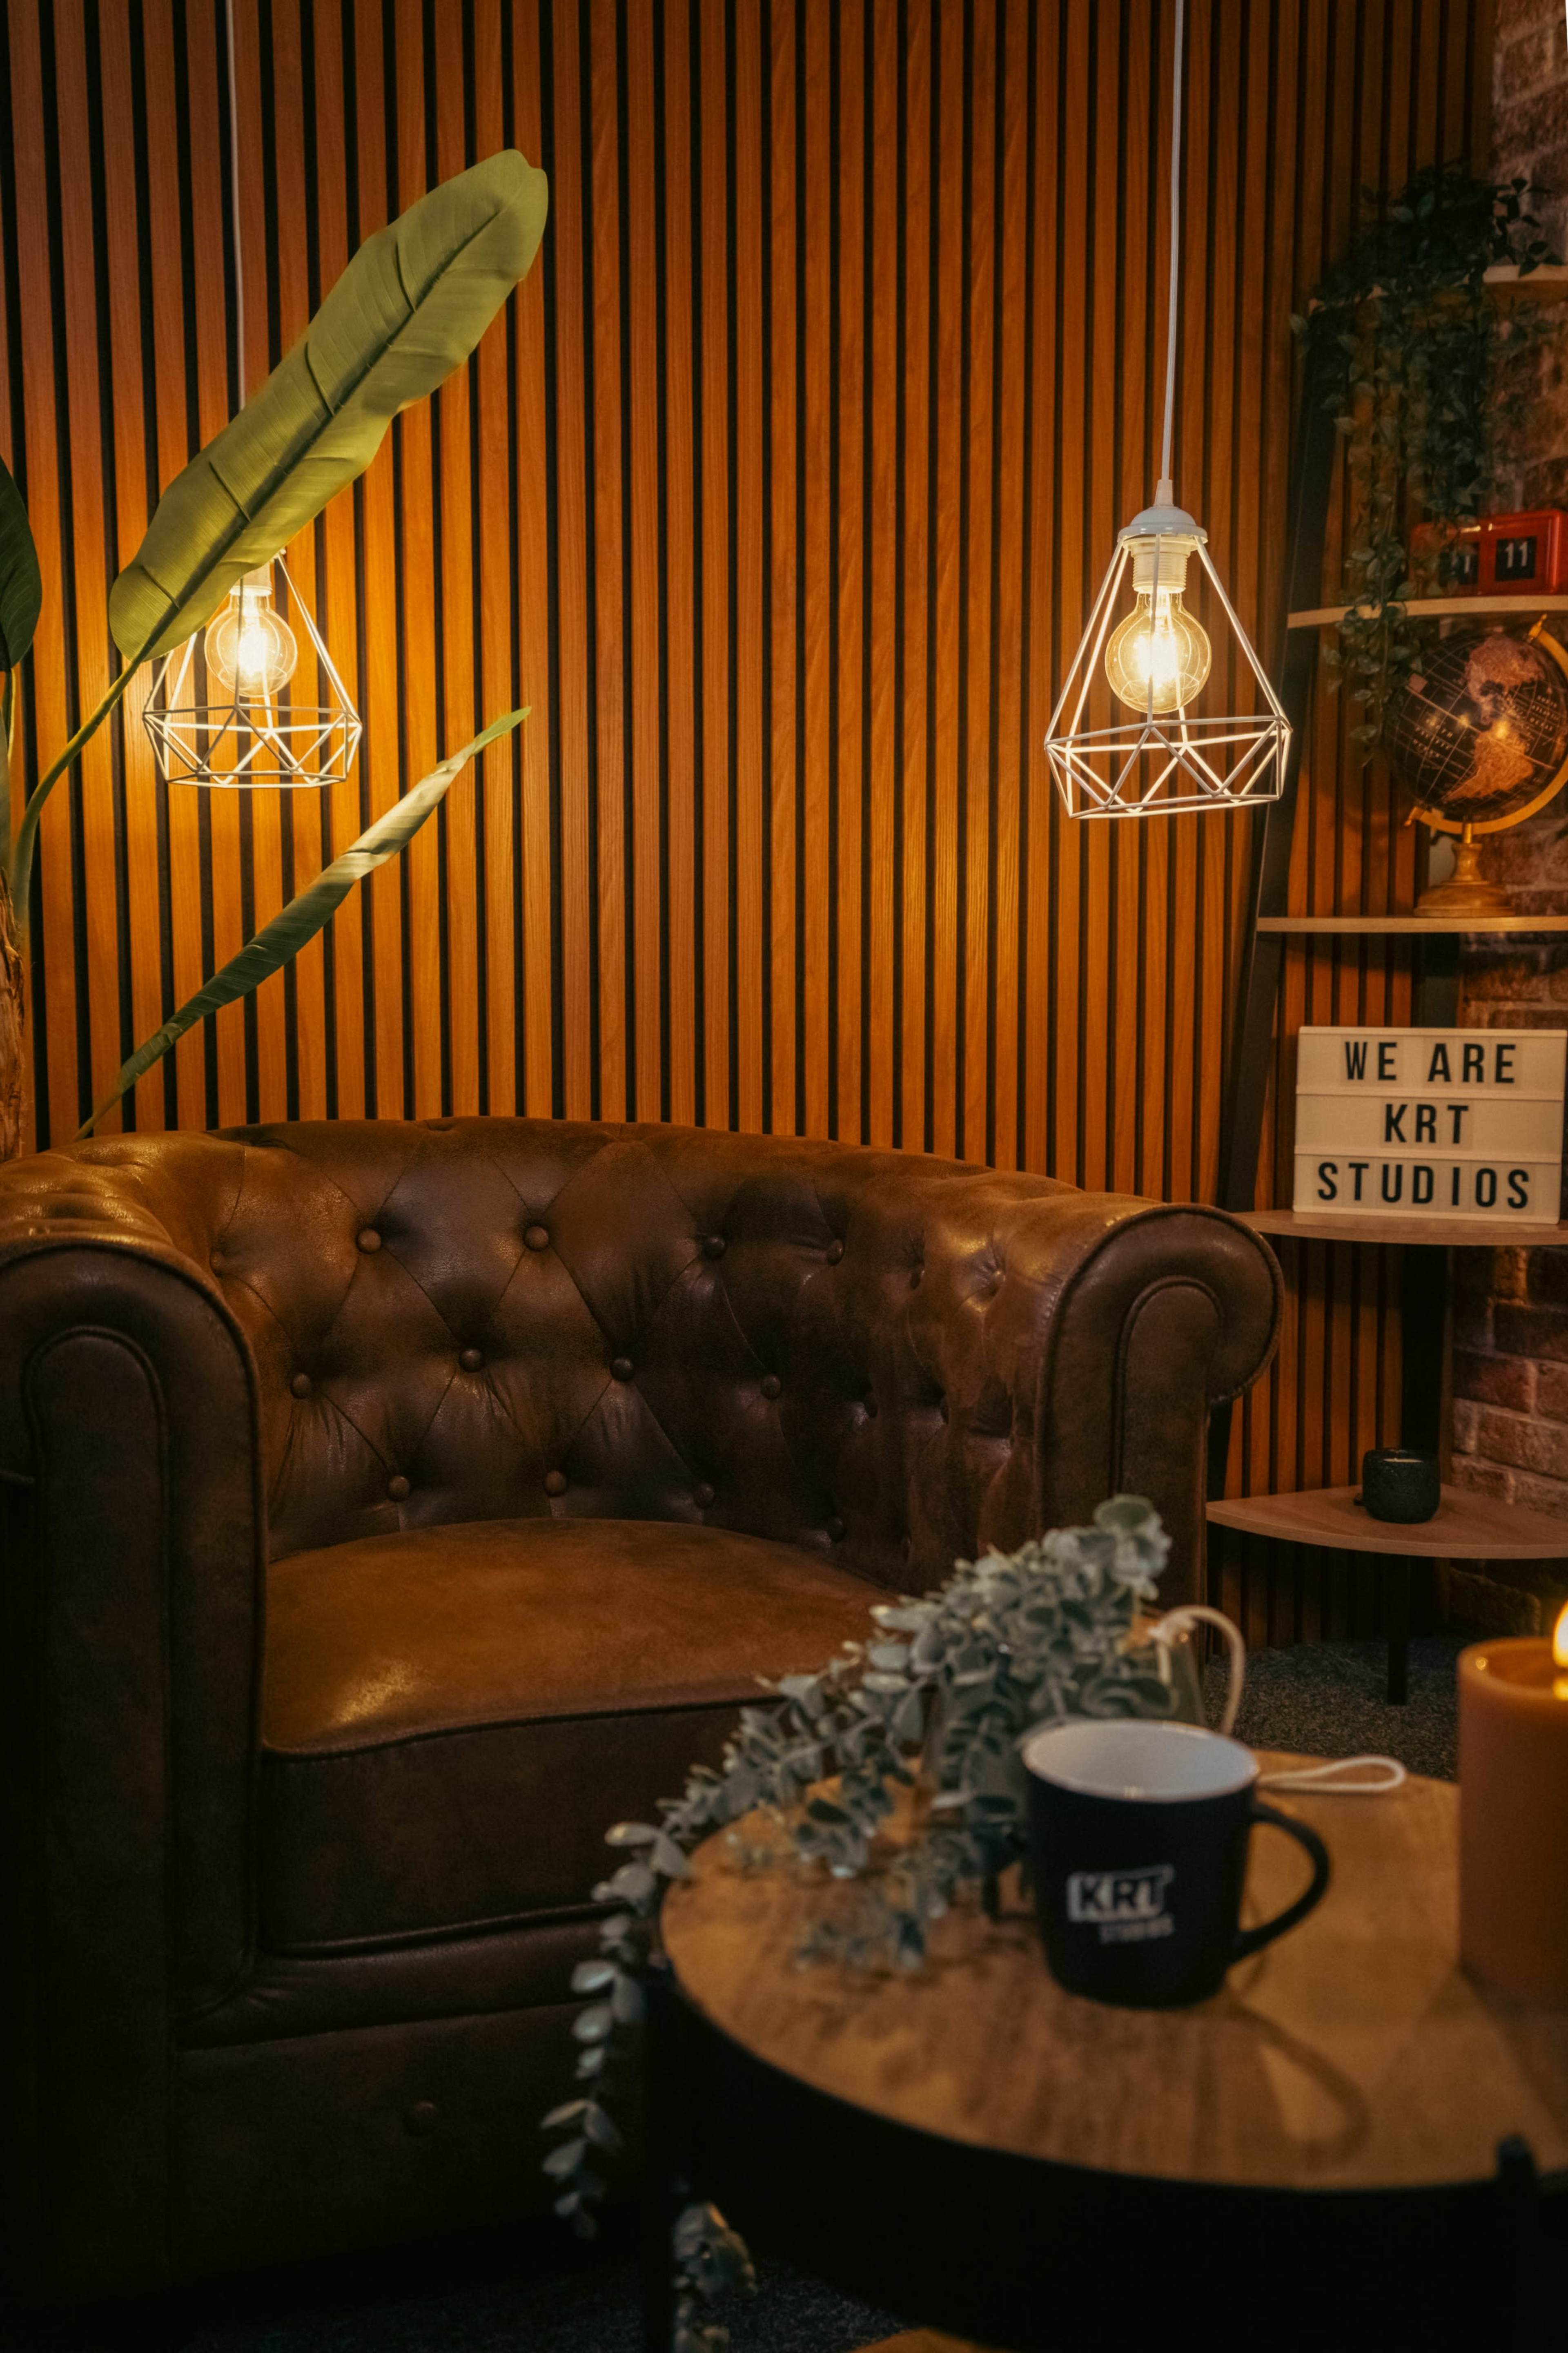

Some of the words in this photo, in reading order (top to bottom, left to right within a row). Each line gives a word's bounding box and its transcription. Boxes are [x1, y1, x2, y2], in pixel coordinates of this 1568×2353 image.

[1505, 541, 1528, 569] 11
[1345, 1042, 1397, 1081] WE
[1427, 1043, 1516, 1084] ARE
[1384, 1104, 1469, 1144] KRT
[1317, 1162, 1530, 1209] STUDIOS
[1074, 1871, 1169, 1918] KRT
